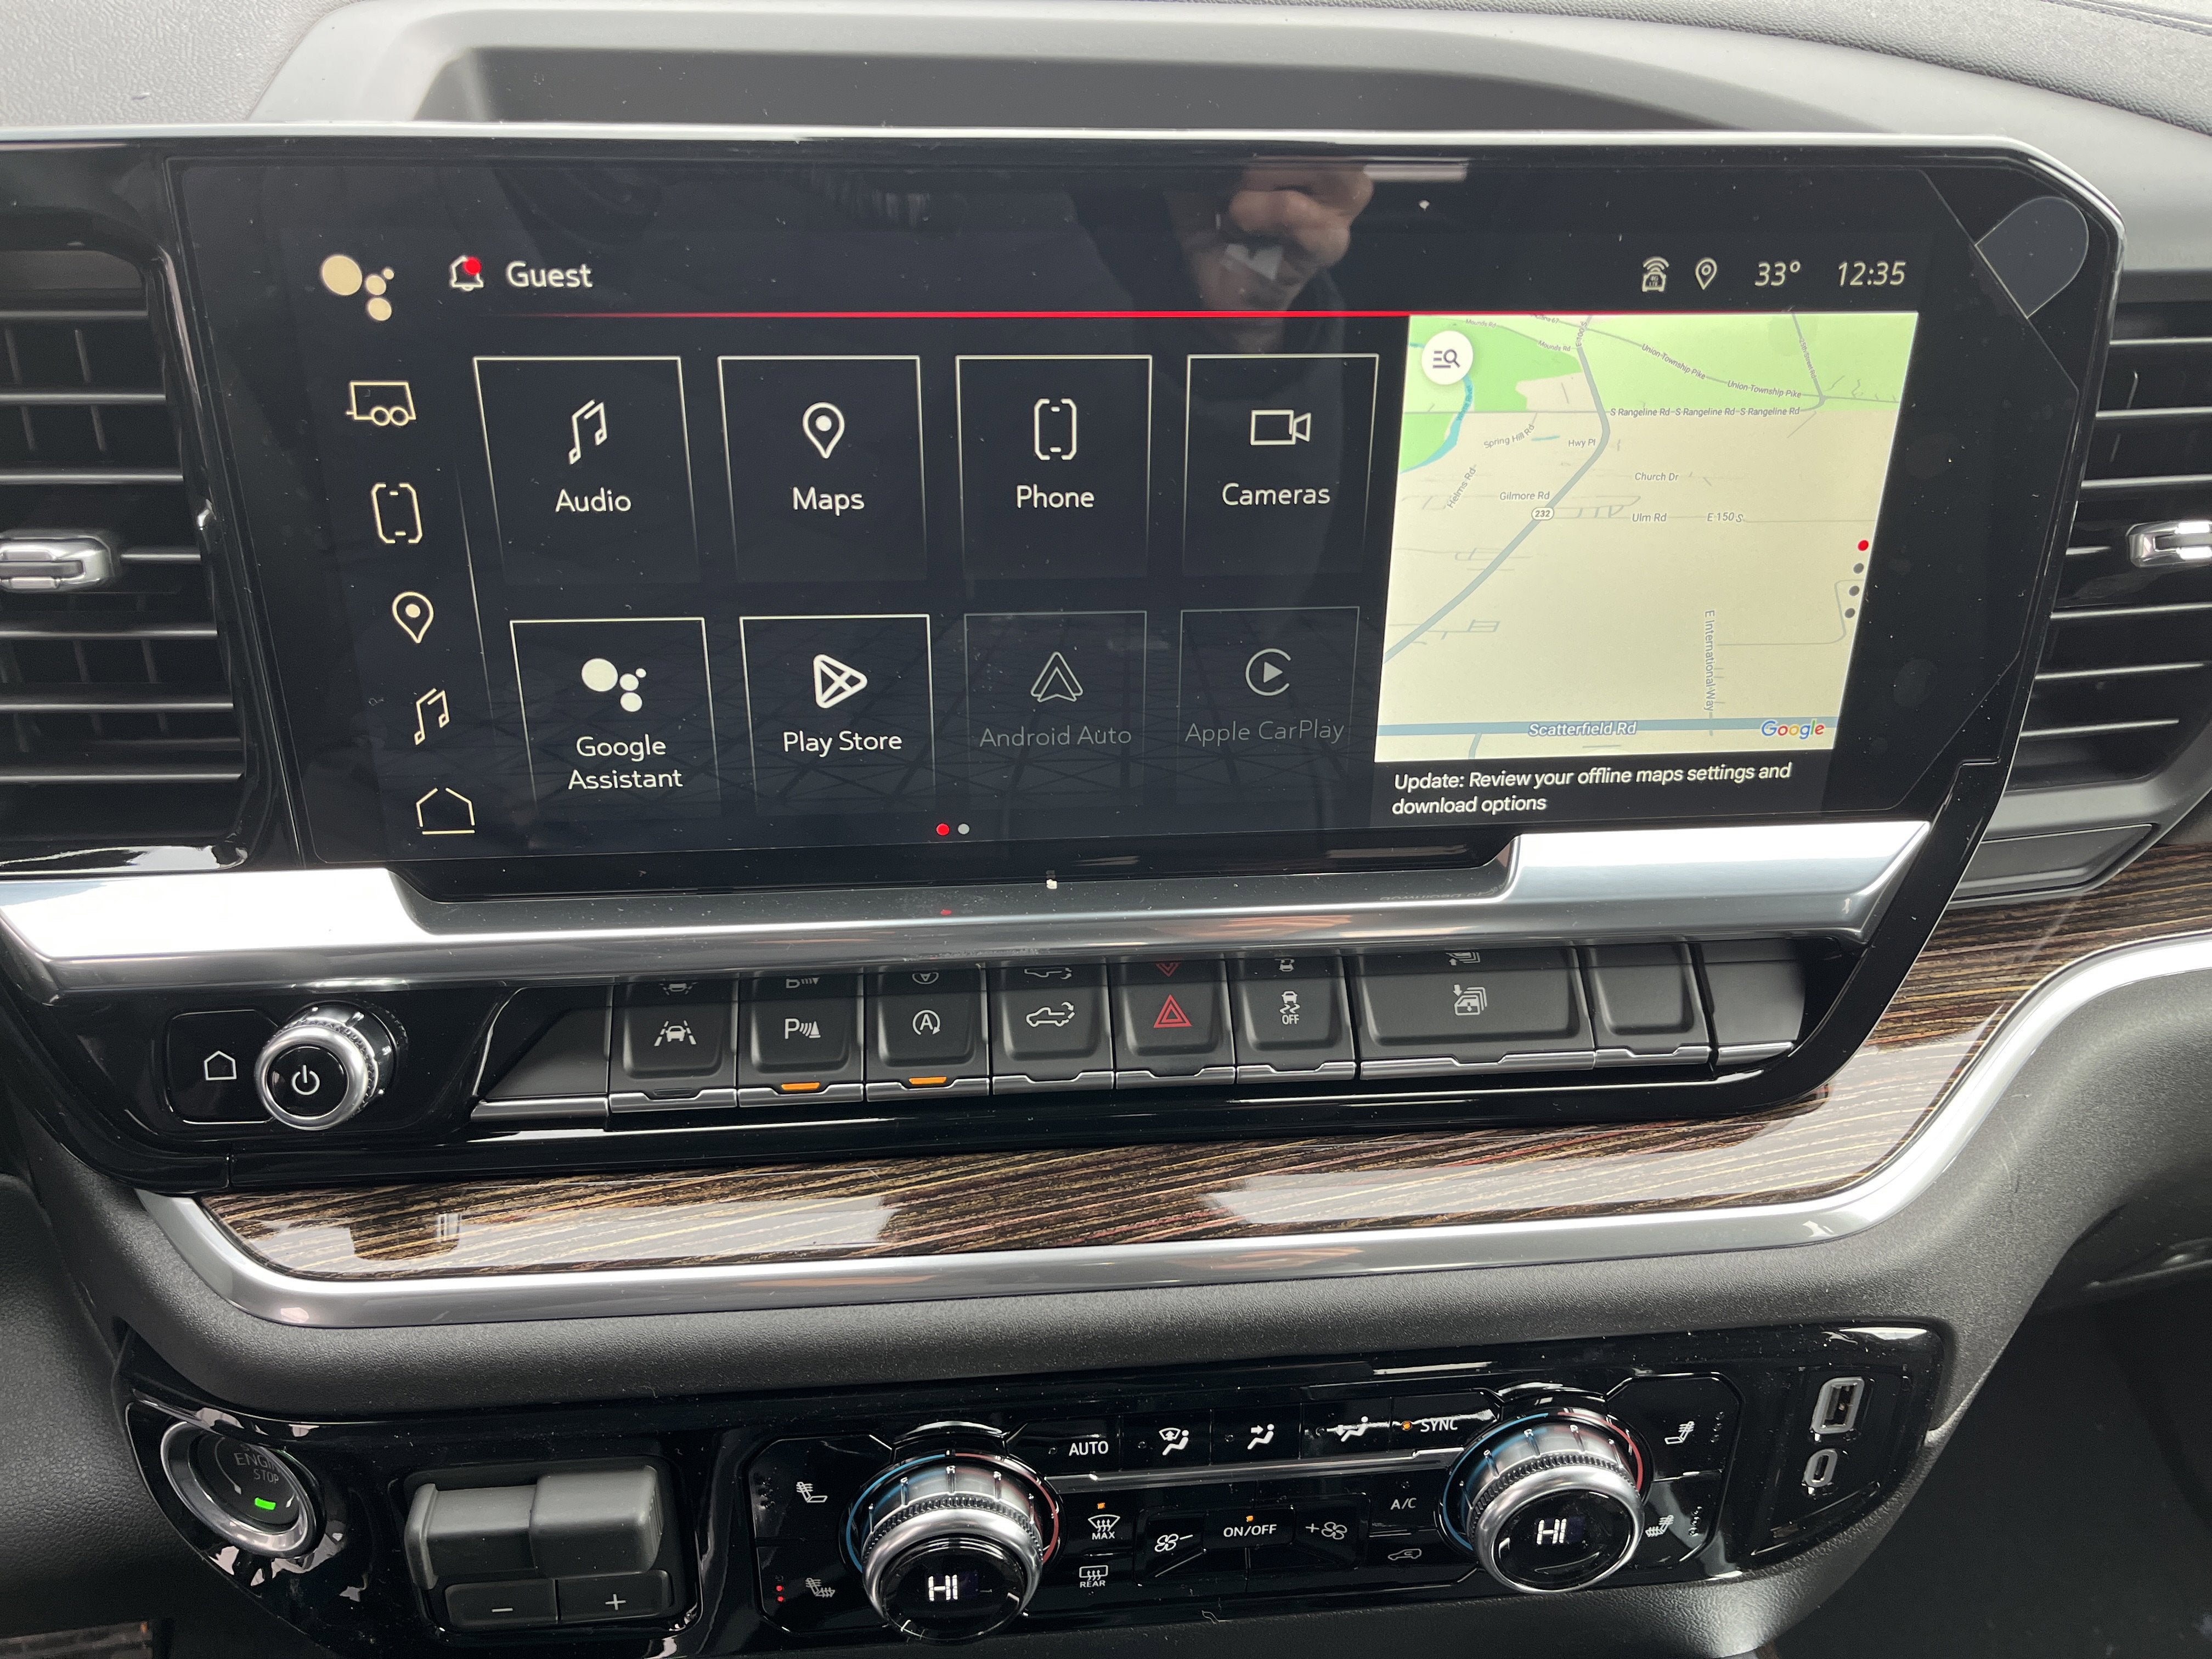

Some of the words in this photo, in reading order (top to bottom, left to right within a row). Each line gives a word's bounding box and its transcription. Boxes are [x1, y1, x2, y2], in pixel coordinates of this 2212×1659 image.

[506, 261, 594, 288] Guest
[1754, 261, 1802, 286] 33°
[1838, 261, 1906, 287] 12:35
[1465, 318, 1487, 328] Mounds
[1538, 340, 1561, 352] Mounds
[1641, 343, 1661, 358] Union
[1661, 352, 1690, 374] Township
[1691, 368, 1706, 380] Pike
[1799, 337, 1808, 352] 25th
[1804, 352, 1814, 371] Street
[1810, 369, 1818, 379] Rd
[1727, 380, 1748, 391] Union
[1750, 384, 1784, 398] Township
[1785, 390, 1802, 398] Pike
[1610, 408, 1616, 416] S
[1618, 408, 1657, 417] Rangeline
[1660, 408, 1670, 416] Rd
[1683, 408, 1723, 417] Rangeline
[1725, 408, 1736, 416] Rd
[1747, 407, 1787, 417] Rangeline
[1789, 407, 1800, 415] Rd
[1483, 437, 1510, 449] Spring
[1511, 432, 1525, 442] Hill
[1523, 424, 1535, 436] Rd
[1568, 439, 1586, 448] Hwy
[1634, 472, 1666, 481] Church
[1668, 472, 1679, 481] Dr
[1016, 484, 1094, 508] Phone
[1222, 482, 1331, 506] Cameras
[1446, 481, 1468, 509] Helms
[1464, 467, 1476, 481] Rd
[1499, 492, 1536, 500] Gilmore
[1537, 491, 1550, 500] Rd
[555, 488, 632, 513] Audio
[792, 486, 865, 516] Maps
[1534, 510, 1551, 518] 232
[1632, 513, 1651, 522] Ulm
[1654, 512, 1667, 522] Rd
[1707, 512, 1714, 522] E
[1716, 512, 1735, 521] 150
[1736, 514, 1743, 523] S
[1705, 620, 1716, 687] International
[1703, 689, 1716, 712] Way
[979, 725, 1071, 748] Android
[1077, 726, 1132, 746] Auto
[1184, 720, 1251, 747] Apple
[1258, 719, 1345, 745] CarPlay
[1528, 721, 1613, 736] Scatterfield
[1617, 721, 1637, 735] Rd
[1761, 720, 1825, 740] Google
[575, 733, 667, 762] Google
[783, 730, 833, 758] Play
[839, 730, 902, 751] Store
[568, 769, 683, 790] Assistant
[1394, 772, 1465, 793] Update:
[1469, 770, 1532, 788] Review
[1534, 772, 1575, 789] your
[1577, 767, 1633, 785] offline
[1635, 769, 1683, 786] maps
[1686, 764, 1755, 783] settings
[1758, 761, 1792, 779] and
[1392, 796, 1477, 815] download
[1481, 797, 1548, 815] options
[784, 1018, 800, 1040] P
[919, 1014, 934, 1032] A
[1282, 1014, 1300, 1025] OFF
[1420, 1418, 1458, 1433] SYNC
[1068, 1441, 1109, 1457] AUTO
[253, 1469, 279, 1484] STOP
[1390, 1497, 1417, 1510] A/C
[1091, 1531, 1115, 1541] MAX
[1223, 1523, 1278, 1538] ON/OFF
[1536, 1518, 1567, 1545] HI
[928, 1573, 958, 1602] HI
[1079, 1579, 1106, 1588] REAR
